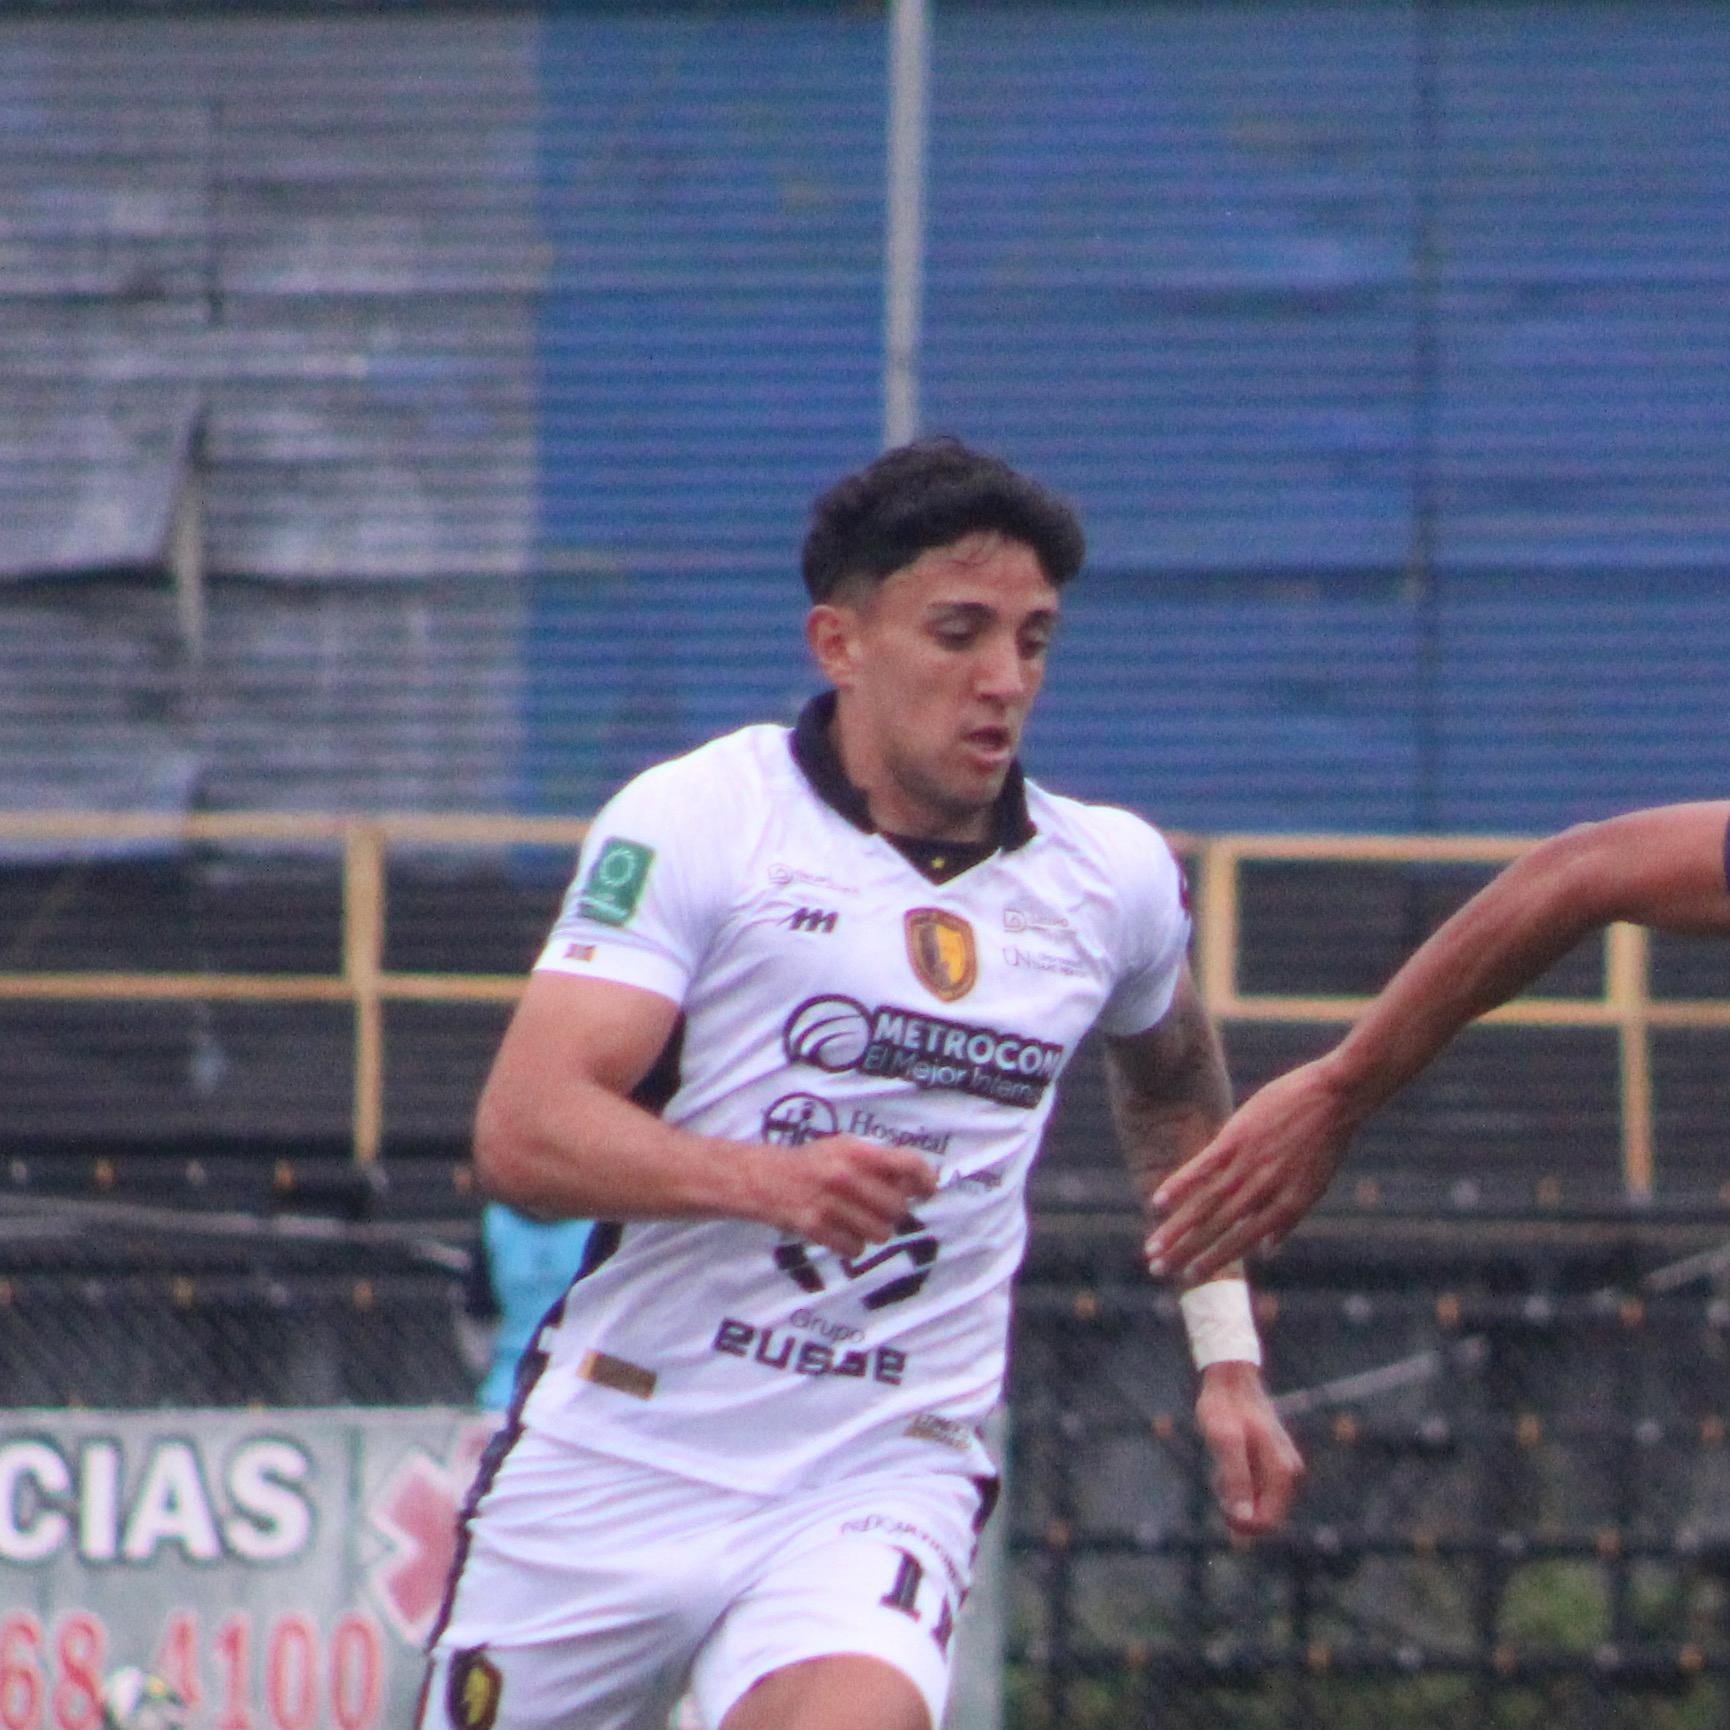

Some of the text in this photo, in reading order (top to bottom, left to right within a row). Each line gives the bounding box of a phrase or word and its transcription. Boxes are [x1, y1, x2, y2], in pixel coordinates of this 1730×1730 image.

[895, 1053, 967, 1087] Mejor
[850, 1109, 950, 1156] Hospital
[790, 1307, 865, 1343] Grupo
[0, 1438, 313, 1562] CIAS
